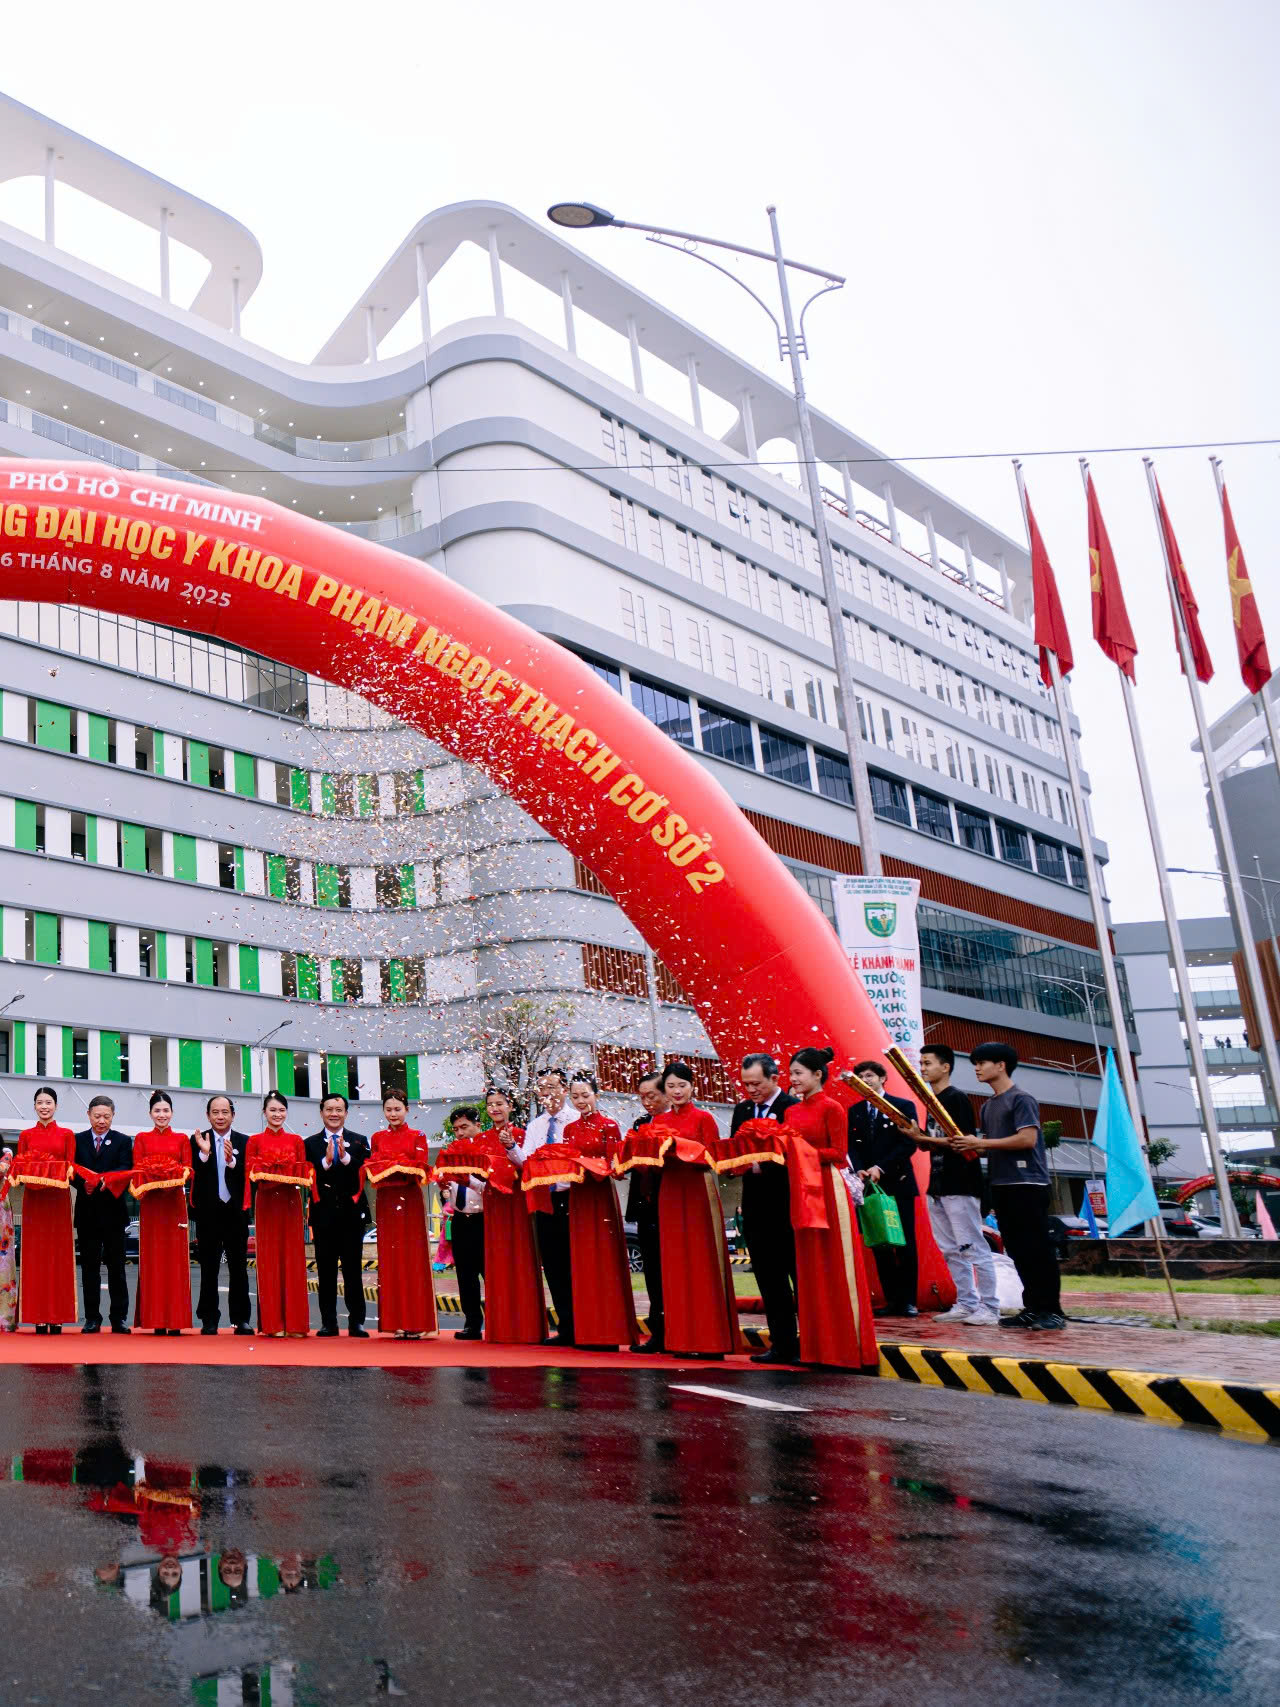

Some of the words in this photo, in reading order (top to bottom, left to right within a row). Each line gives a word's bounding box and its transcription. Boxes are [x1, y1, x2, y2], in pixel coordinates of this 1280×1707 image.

[9, 470, 69, 492] PHỐ
[77, 476, 120, 499] HỒ
[130, 488, 182, 513] CHÍ
[185, 498, 263, 532] MINH
[18, 552, 93, 574] THÁNG
[99, 564, 113, 578] 8
[120, 568, 170, 592] NĂM
[180, 582, 232, 607] 2025
[36, 505, 97, 548] ĐẠI
[101, 514, 176, 560] HỌC
[182, 530, 208, 566] Y
[207, 538, 304, 600] KHOA
[306, 574, 418, 648] PHẠM
[414, 625, 513, 703] NGỌC
[508, 683, 621, 784] THẠCH
[609, 774, 669, 824] CƠ
[652, 813, 712, 867] SỞ
[685, 862, 725, 894] 2
